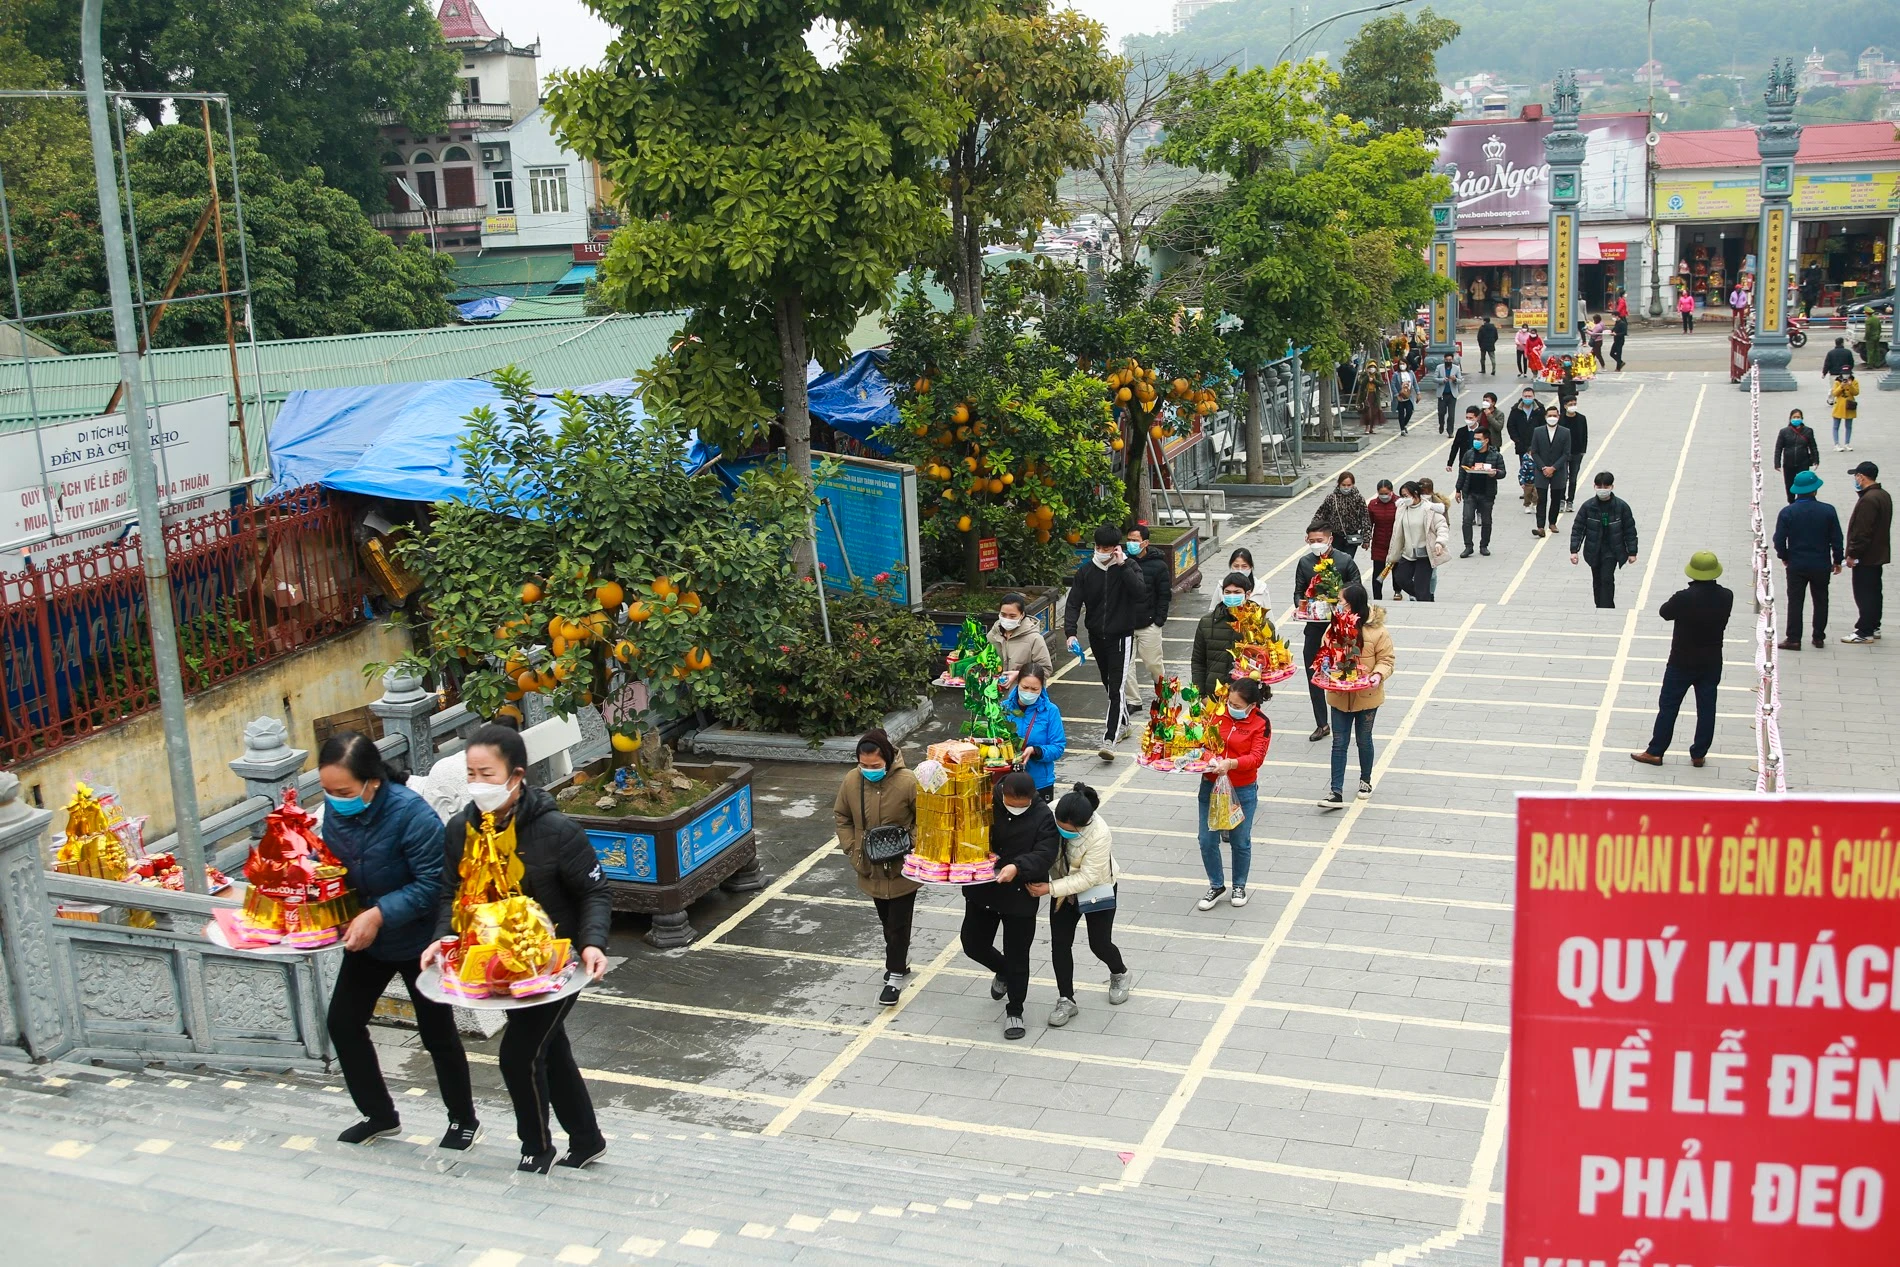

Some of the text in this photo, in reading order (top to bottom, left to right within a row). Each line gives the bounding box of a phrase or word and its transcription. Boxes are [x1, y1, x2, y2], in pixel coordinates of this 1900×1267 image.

[51, 447, 81, 467] ĐỀN
[86, 444, 105, 459] BÀ
[150, 430, 179, 446] KHO
[78, 432, 89, 443] DI
[91, 426, 114, 440] TÍCH
[116, 424, 129, 437] LỊC
[21, 486, 40, 508] QUÝ
[84, 473, 97, 493] VỀ
[99, 469, 110, 489] LỄ
[24, 513, 49, 532] MUA
[88, 497, 110, 517] TÂM
[180, 472, 209, 493] THUẬN
[1530, 833, 1588, 891] BAN
[1595, 814, 1674, 899] QUẢN
[1680, 824, 1713, 895] LÝ
[1719, 816, 1778, 896] ĐỀN
[1785, 825, 1824, 898] BÀ
[1557, 925, 1687, 1008] QUÝ
[1572, 1028, 1900, 1122] VỀ LỄ ĐỀN
[1578, 1137, 1884, 1230] PHẢI ĐEO
